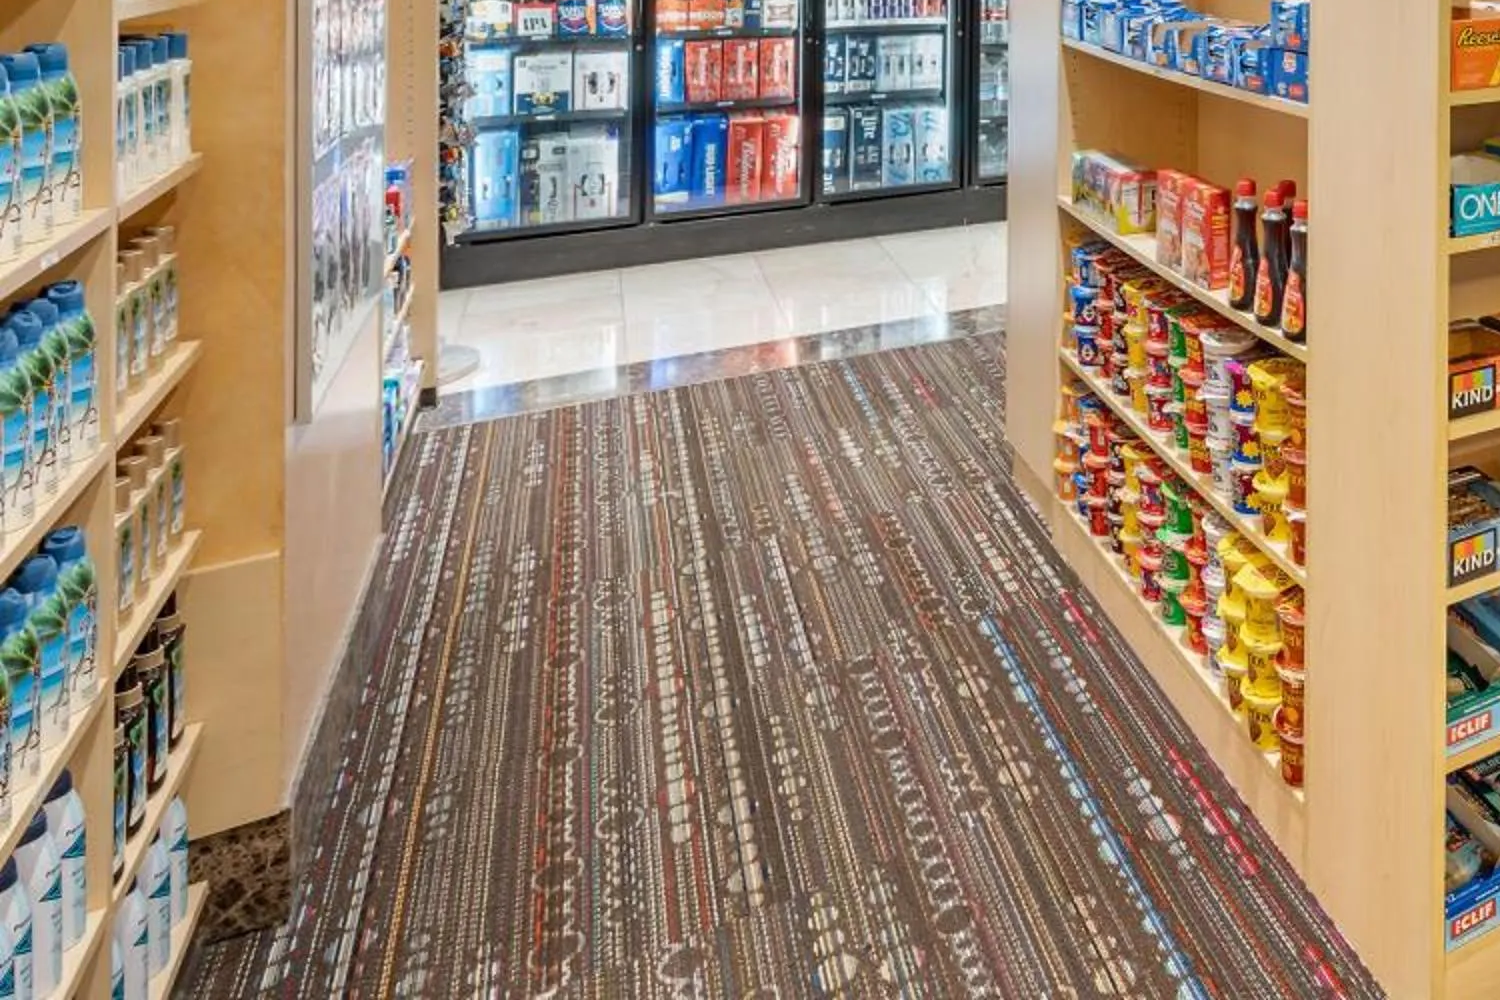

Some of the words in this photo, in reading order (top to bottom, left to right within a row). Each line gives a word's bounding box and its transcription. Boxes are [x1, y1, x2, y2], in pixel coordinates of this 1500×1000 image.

[1452, 386, 1493, 410] KIND
[1452, 549, 1496, 577] KIND
[1456, 712, 1490, 739] CLIF
[1461, 900, 1495, 930] CLIF
